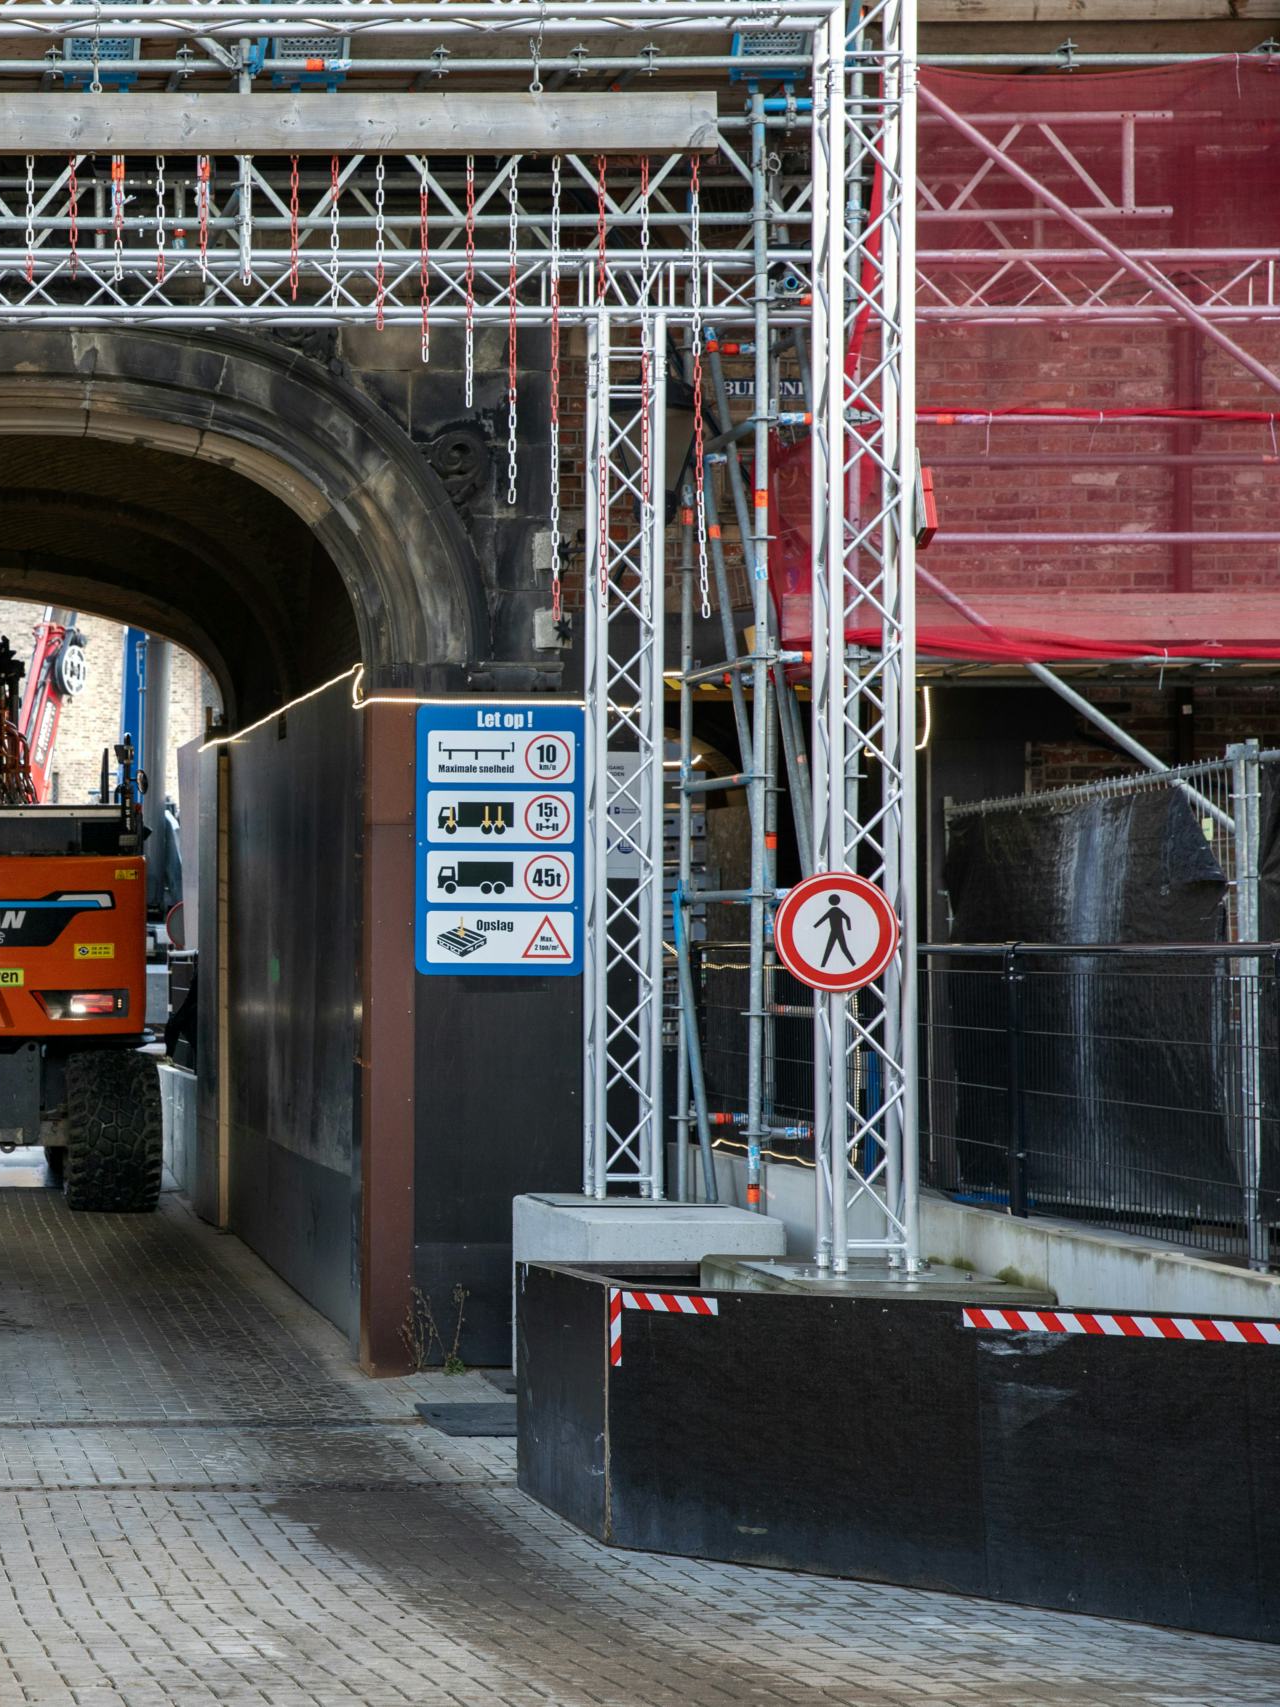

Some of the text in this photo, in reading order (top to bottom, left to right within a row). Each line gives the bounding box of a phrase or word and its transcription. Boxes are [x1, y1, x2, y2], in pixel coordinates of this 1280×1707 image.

[477, 711, 533, 729] Let op !
[537, 744, 556, 763] 10
[438, 764, 514, 774] Maximale snelheid
[537, 802, 558, 818] 15t
[532, 868, 562, 887] 45t
[476, 919, 514, 932] Opslag
